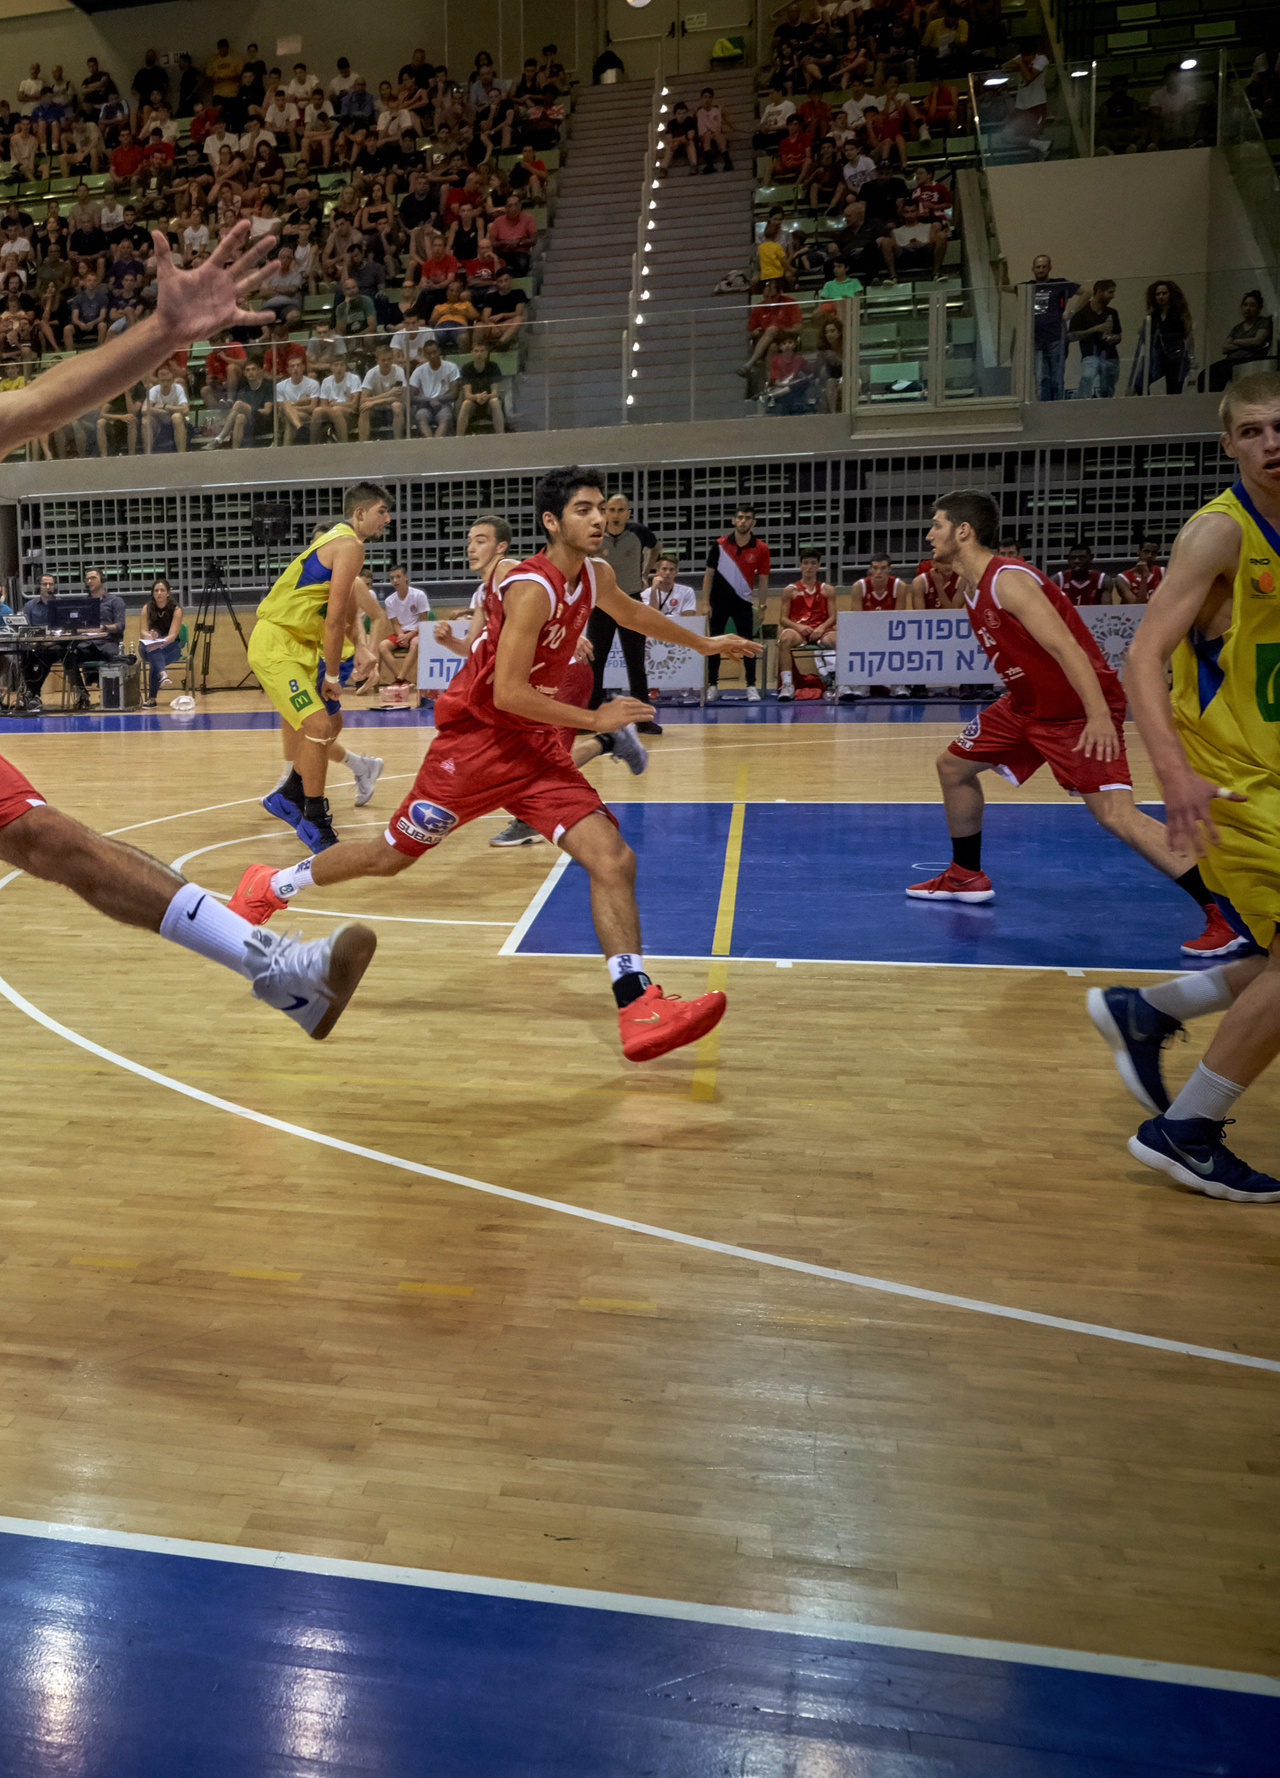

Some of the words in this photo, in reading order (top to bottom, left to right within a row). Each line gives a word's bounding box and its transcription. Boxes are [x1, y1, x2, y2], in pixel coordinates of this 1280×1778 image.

[542, 623, 566, 650] 10
[888, 618, 973, 641] ספורט
[848, 650, 943, 677] הפסקה
[288, 679, 299, 693] 8
